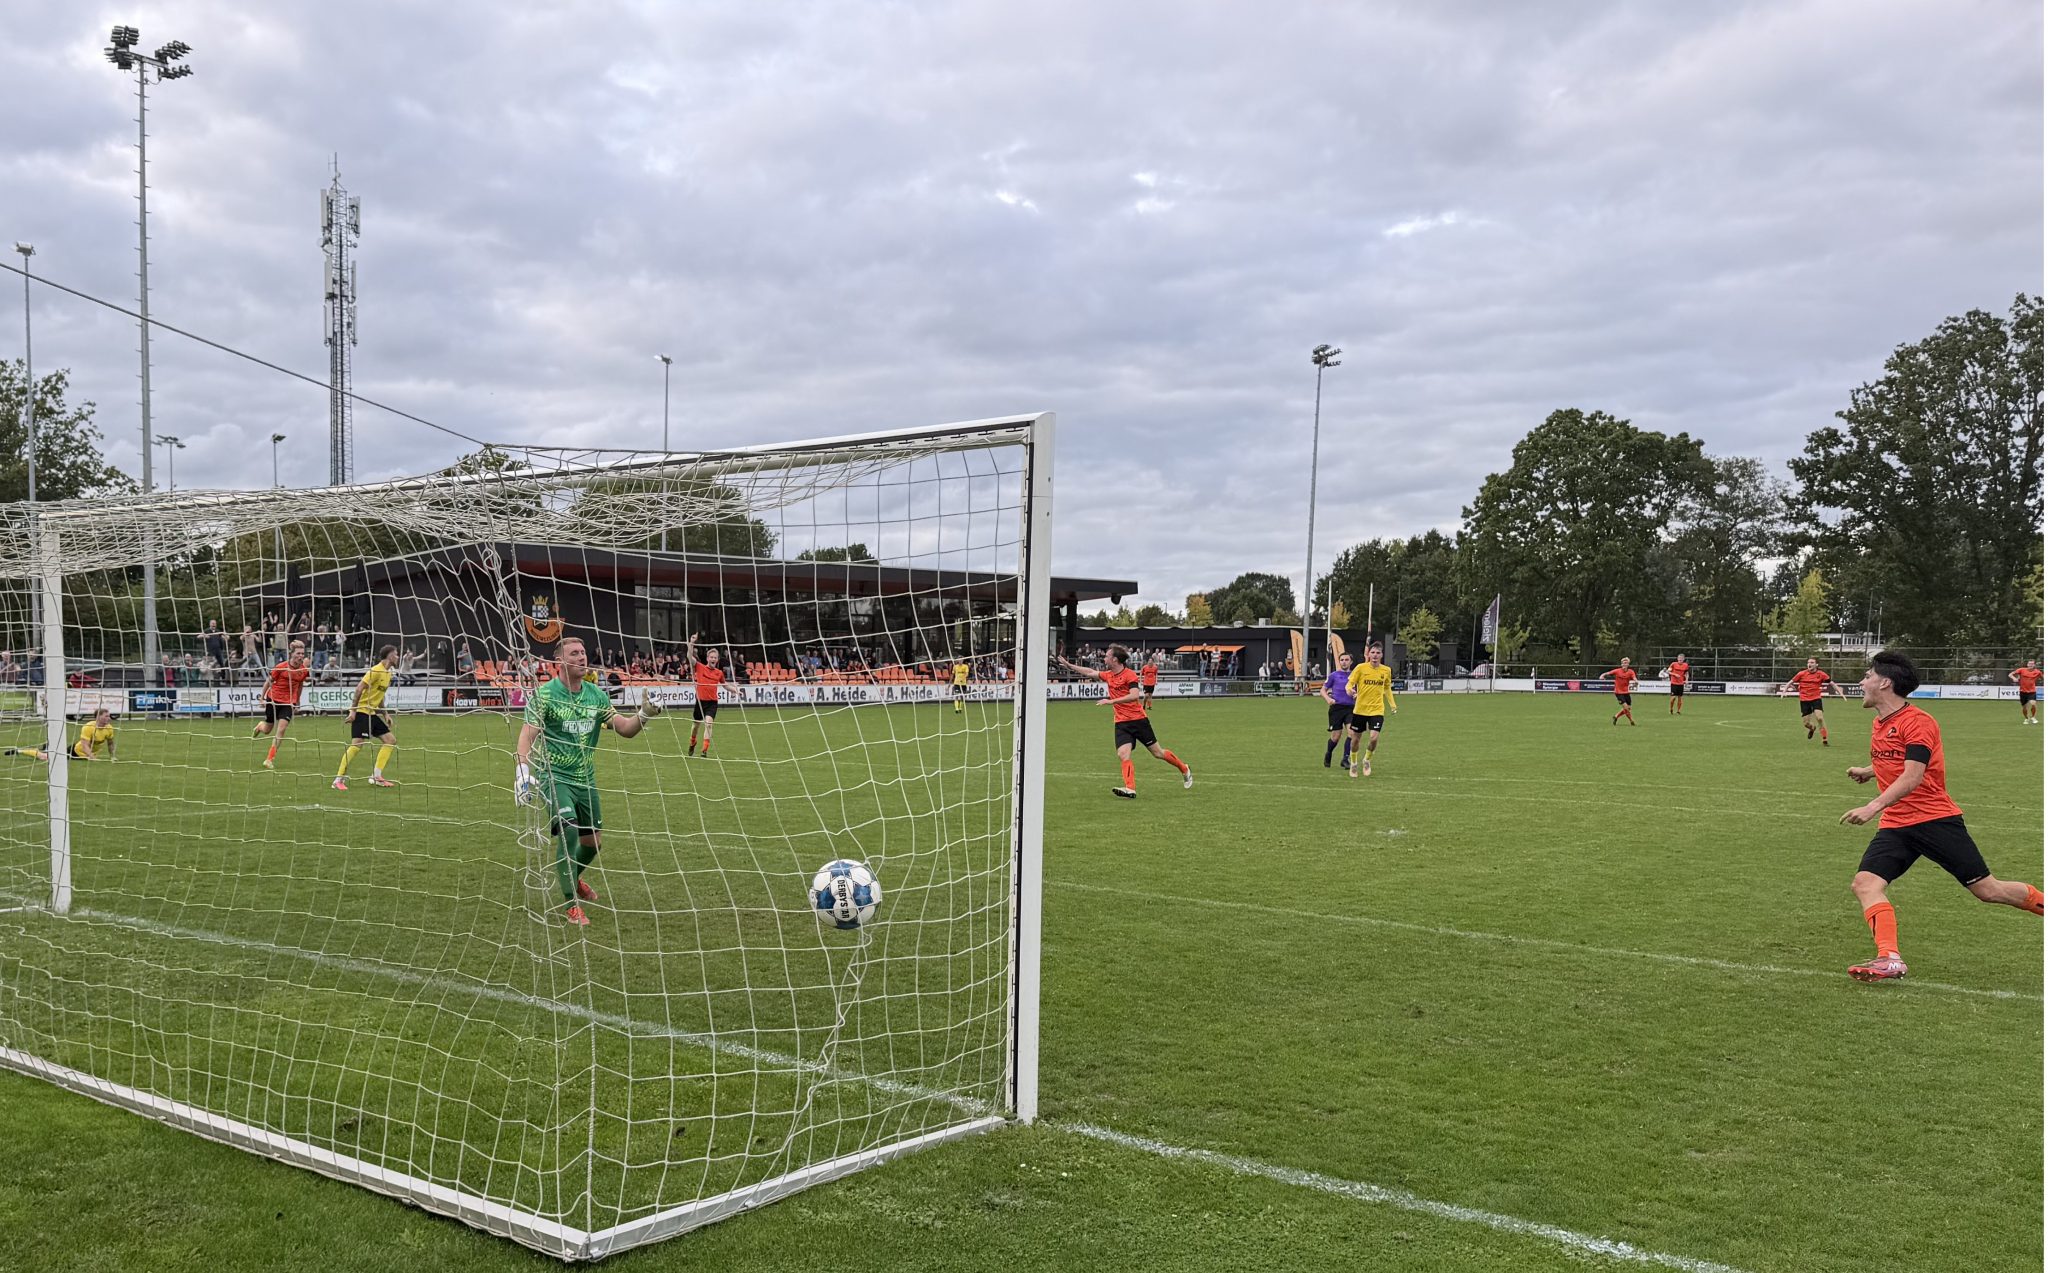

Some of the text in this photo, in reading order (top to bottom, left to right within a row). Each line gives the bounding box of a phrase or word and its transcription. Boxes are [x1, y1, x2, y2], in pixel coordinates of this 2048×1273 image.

[228, 693, 247, 702] van
[755, 687, 795, 702] Heide
[816, 688, 829, 701] A.
[832, 687, 867, 701] Heide
[886, 686, 933, 701] A. Heide
[1066, 685, 1077, 698] A.
[1078, 684, 1105, 698] Heide
